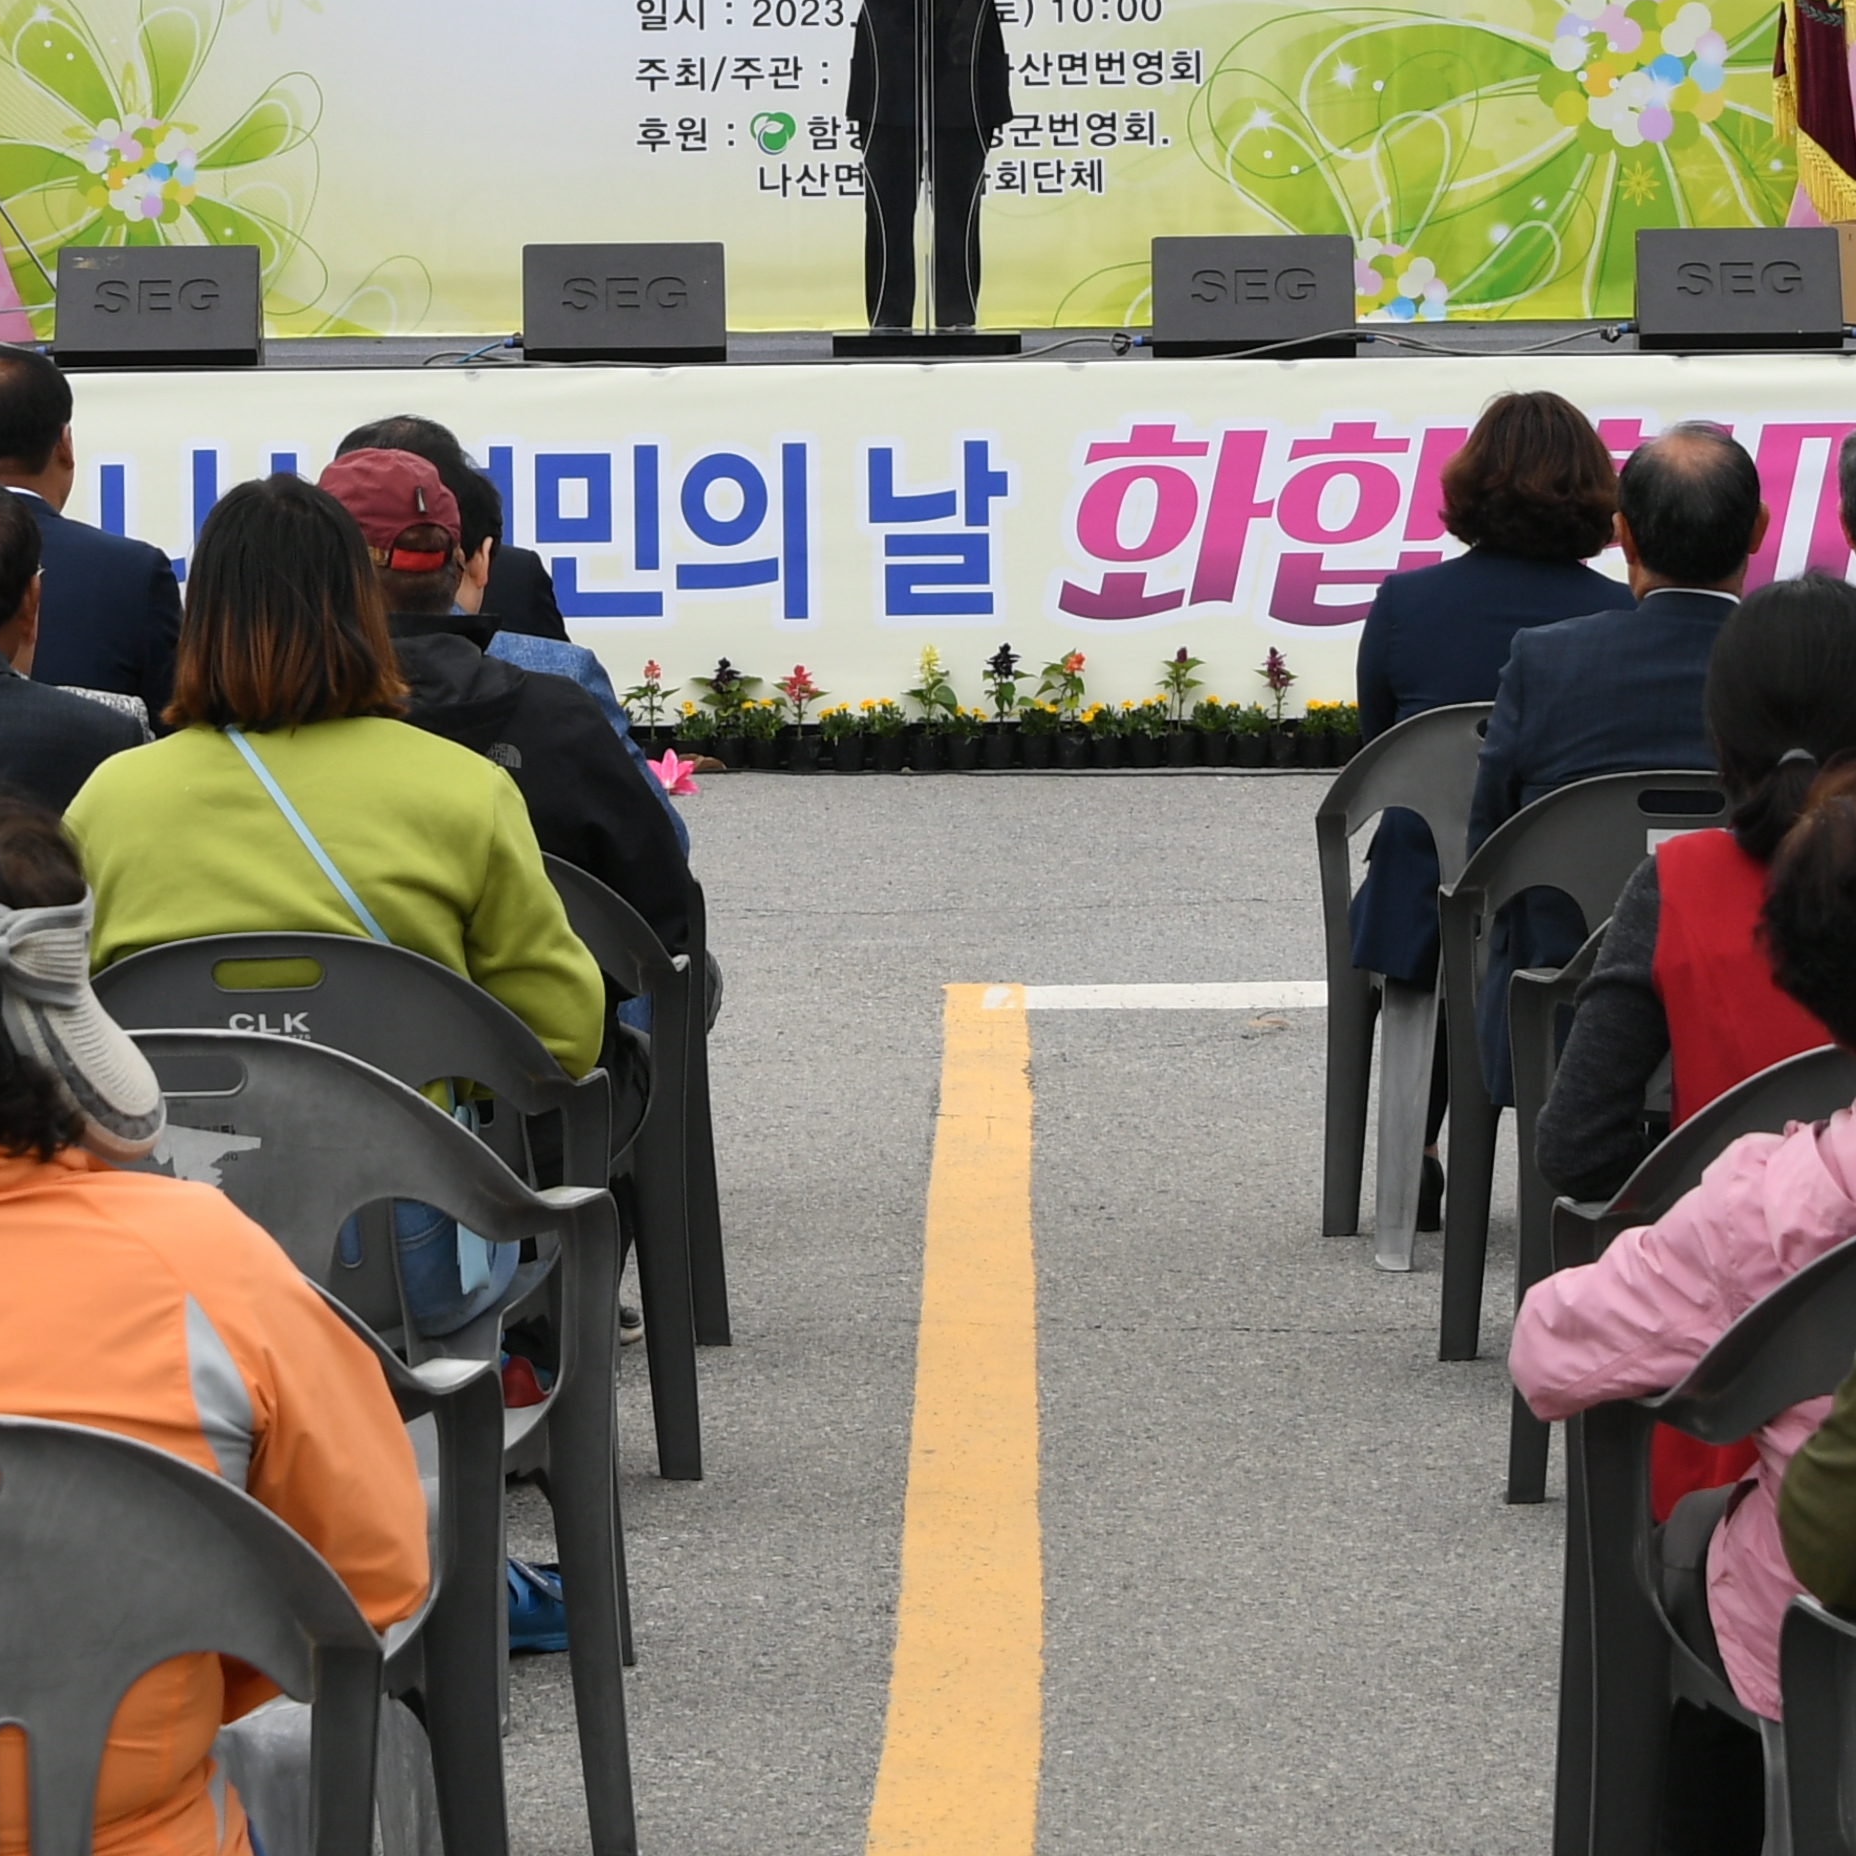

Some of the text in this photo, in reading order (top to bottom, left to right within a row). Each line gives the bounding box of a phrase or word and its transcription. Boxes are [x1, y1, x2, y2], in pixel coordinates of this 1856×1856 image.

[635, 55, 803, 93] 주최/주관
[1008, 49, 1202, 86] 산면번영회
[636, 116, 709, 153] 후원
[990, 110, 1170, 148] 군번영회.
[984, 158, 1104, 195] 회단체
[94, 278, 220, 315] SEG
[561, 275, 688, 313] SEG
[1190, 267, 1317, 305] SEG
[1676, 260, 1805, 297] SEG
[869, 440, 1008, 616] 날
[229, 1012, 311, 1033] CLK
